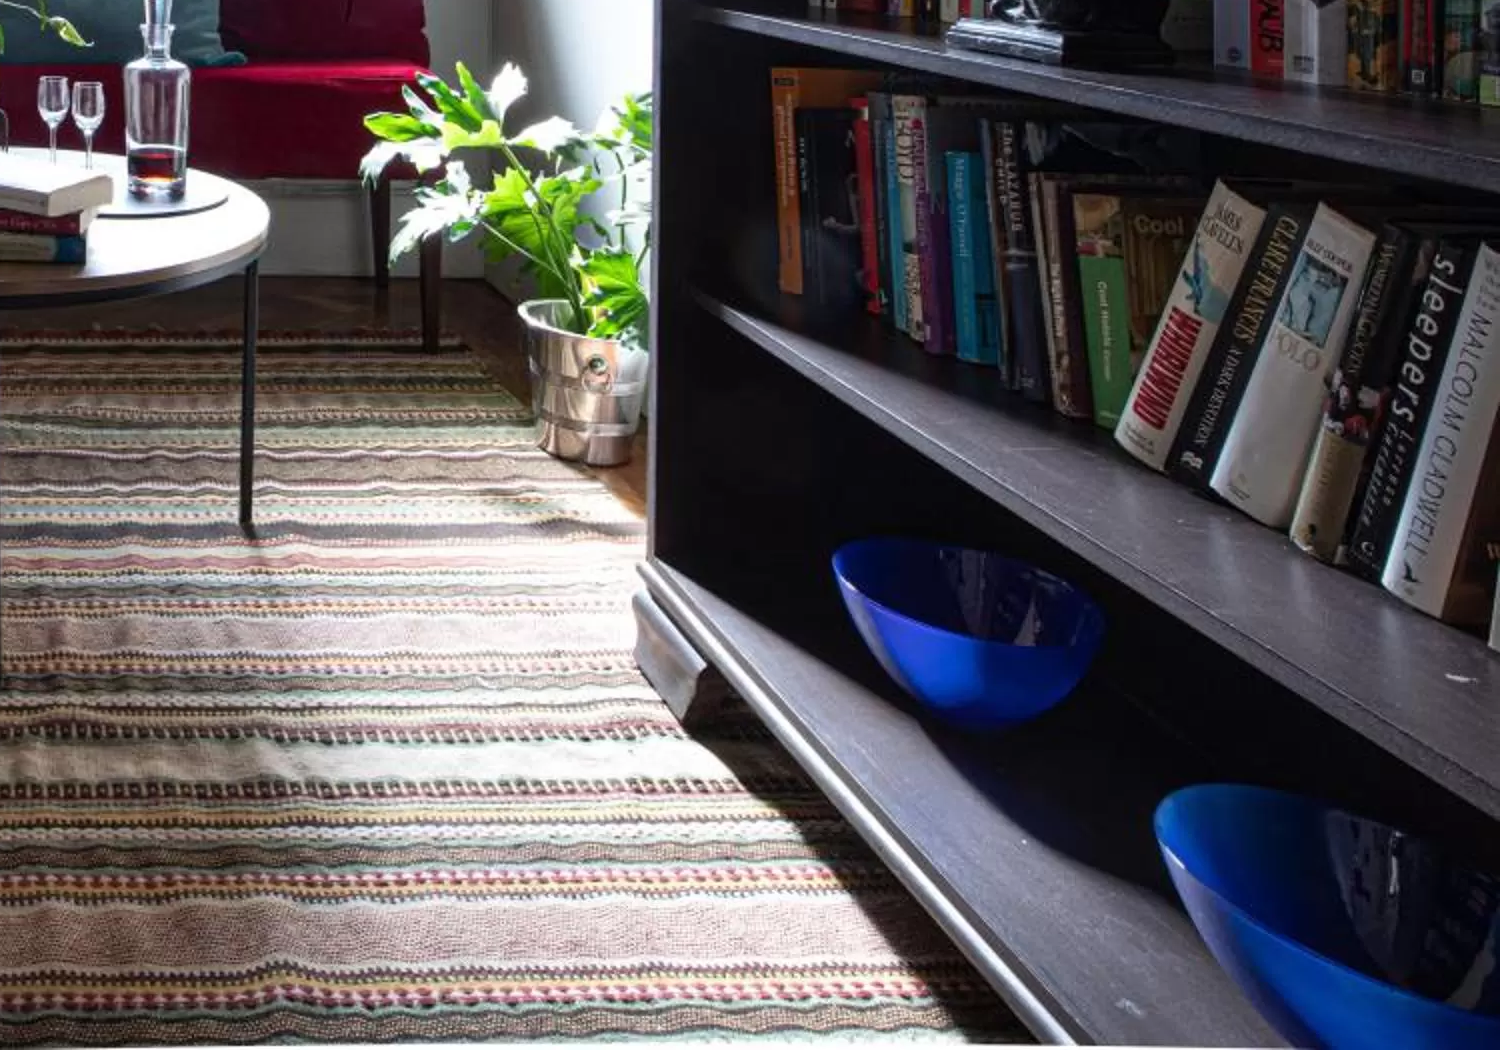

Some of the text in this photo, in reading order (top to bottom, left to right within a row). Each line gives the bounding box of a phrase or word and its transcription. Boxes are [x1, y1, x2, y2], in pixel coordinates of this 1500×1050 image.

[1132, 213, 1185, 234] Cool
[1261, 215, 1299, 274] CLARE
[1132, 305, 1202, 430] WHIRLWIND
[1220, 356, 1242, 384] DARK
[1390, 252, 1464, 424] sleepers
[1403, 314, 1494, 560] MALCOLM GLADWELL
